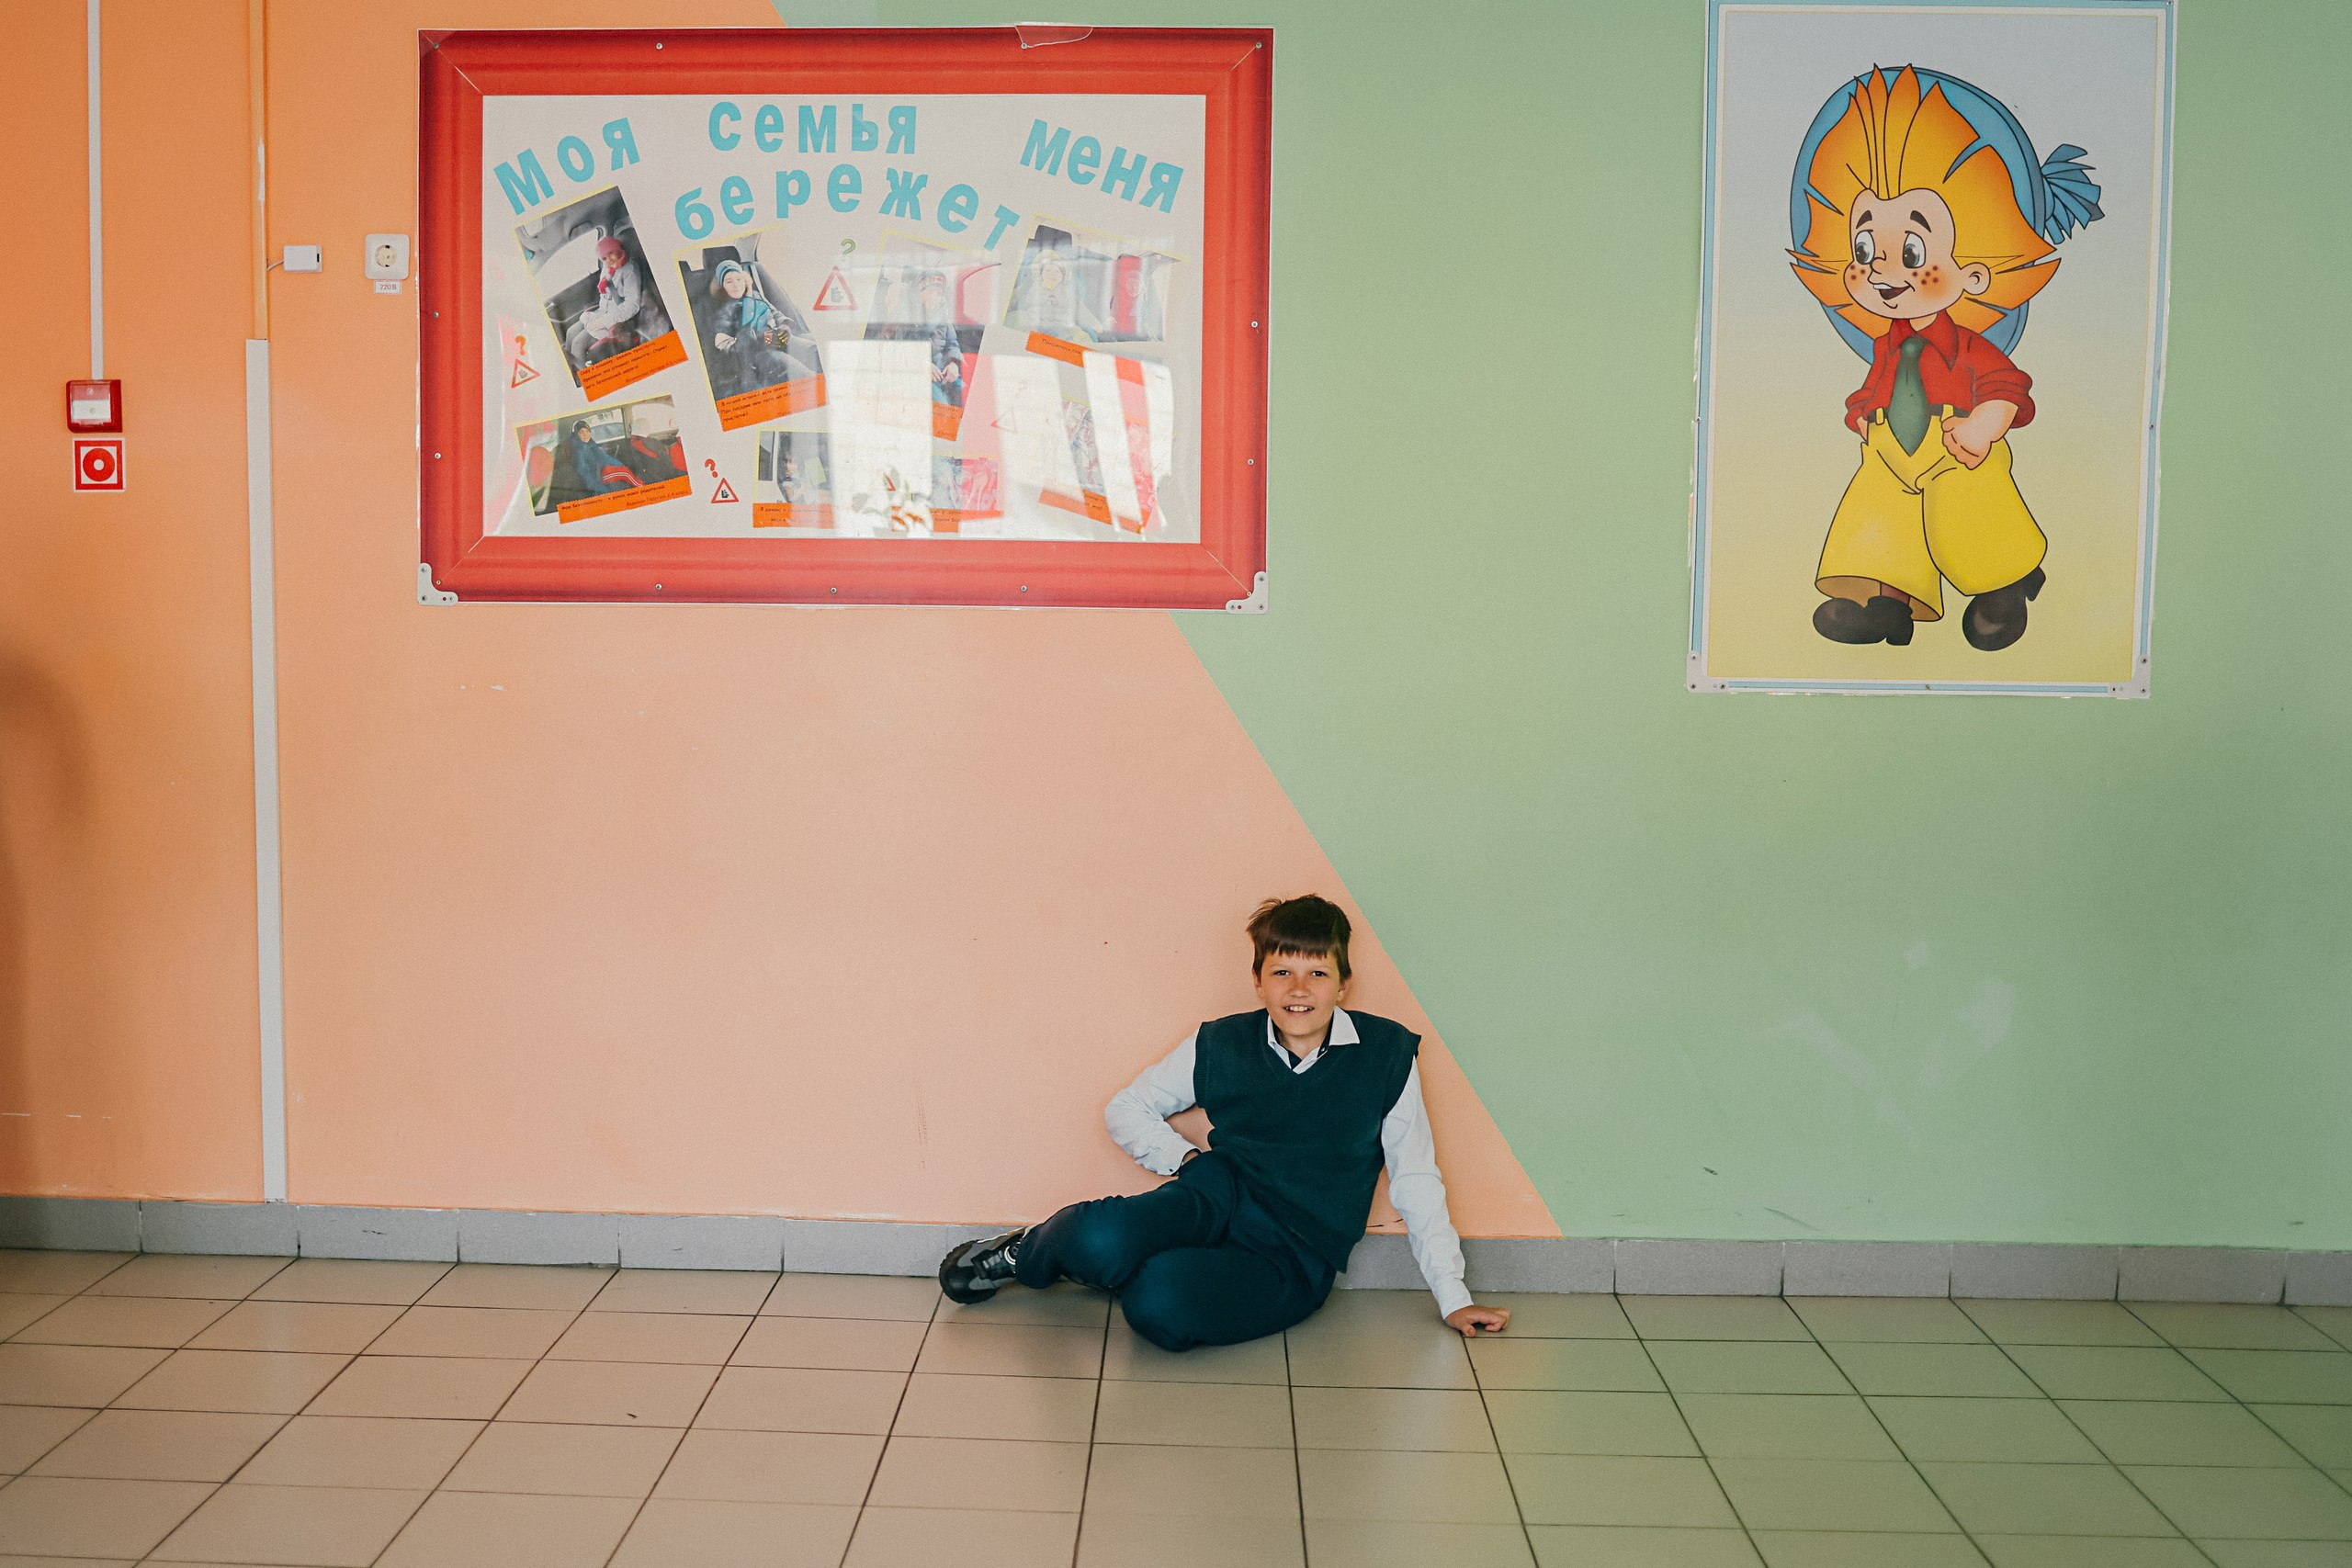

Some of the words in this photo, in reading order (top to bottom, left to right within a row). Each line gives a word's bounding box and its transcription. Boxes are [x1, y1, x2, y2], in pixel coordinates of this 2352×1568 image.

[493, 117, 640, 216] Моя
[708, 101, 917, 155] семья
[1020, 118, 1184, 214] меня
[674, 163, 1020, 251] бережет
